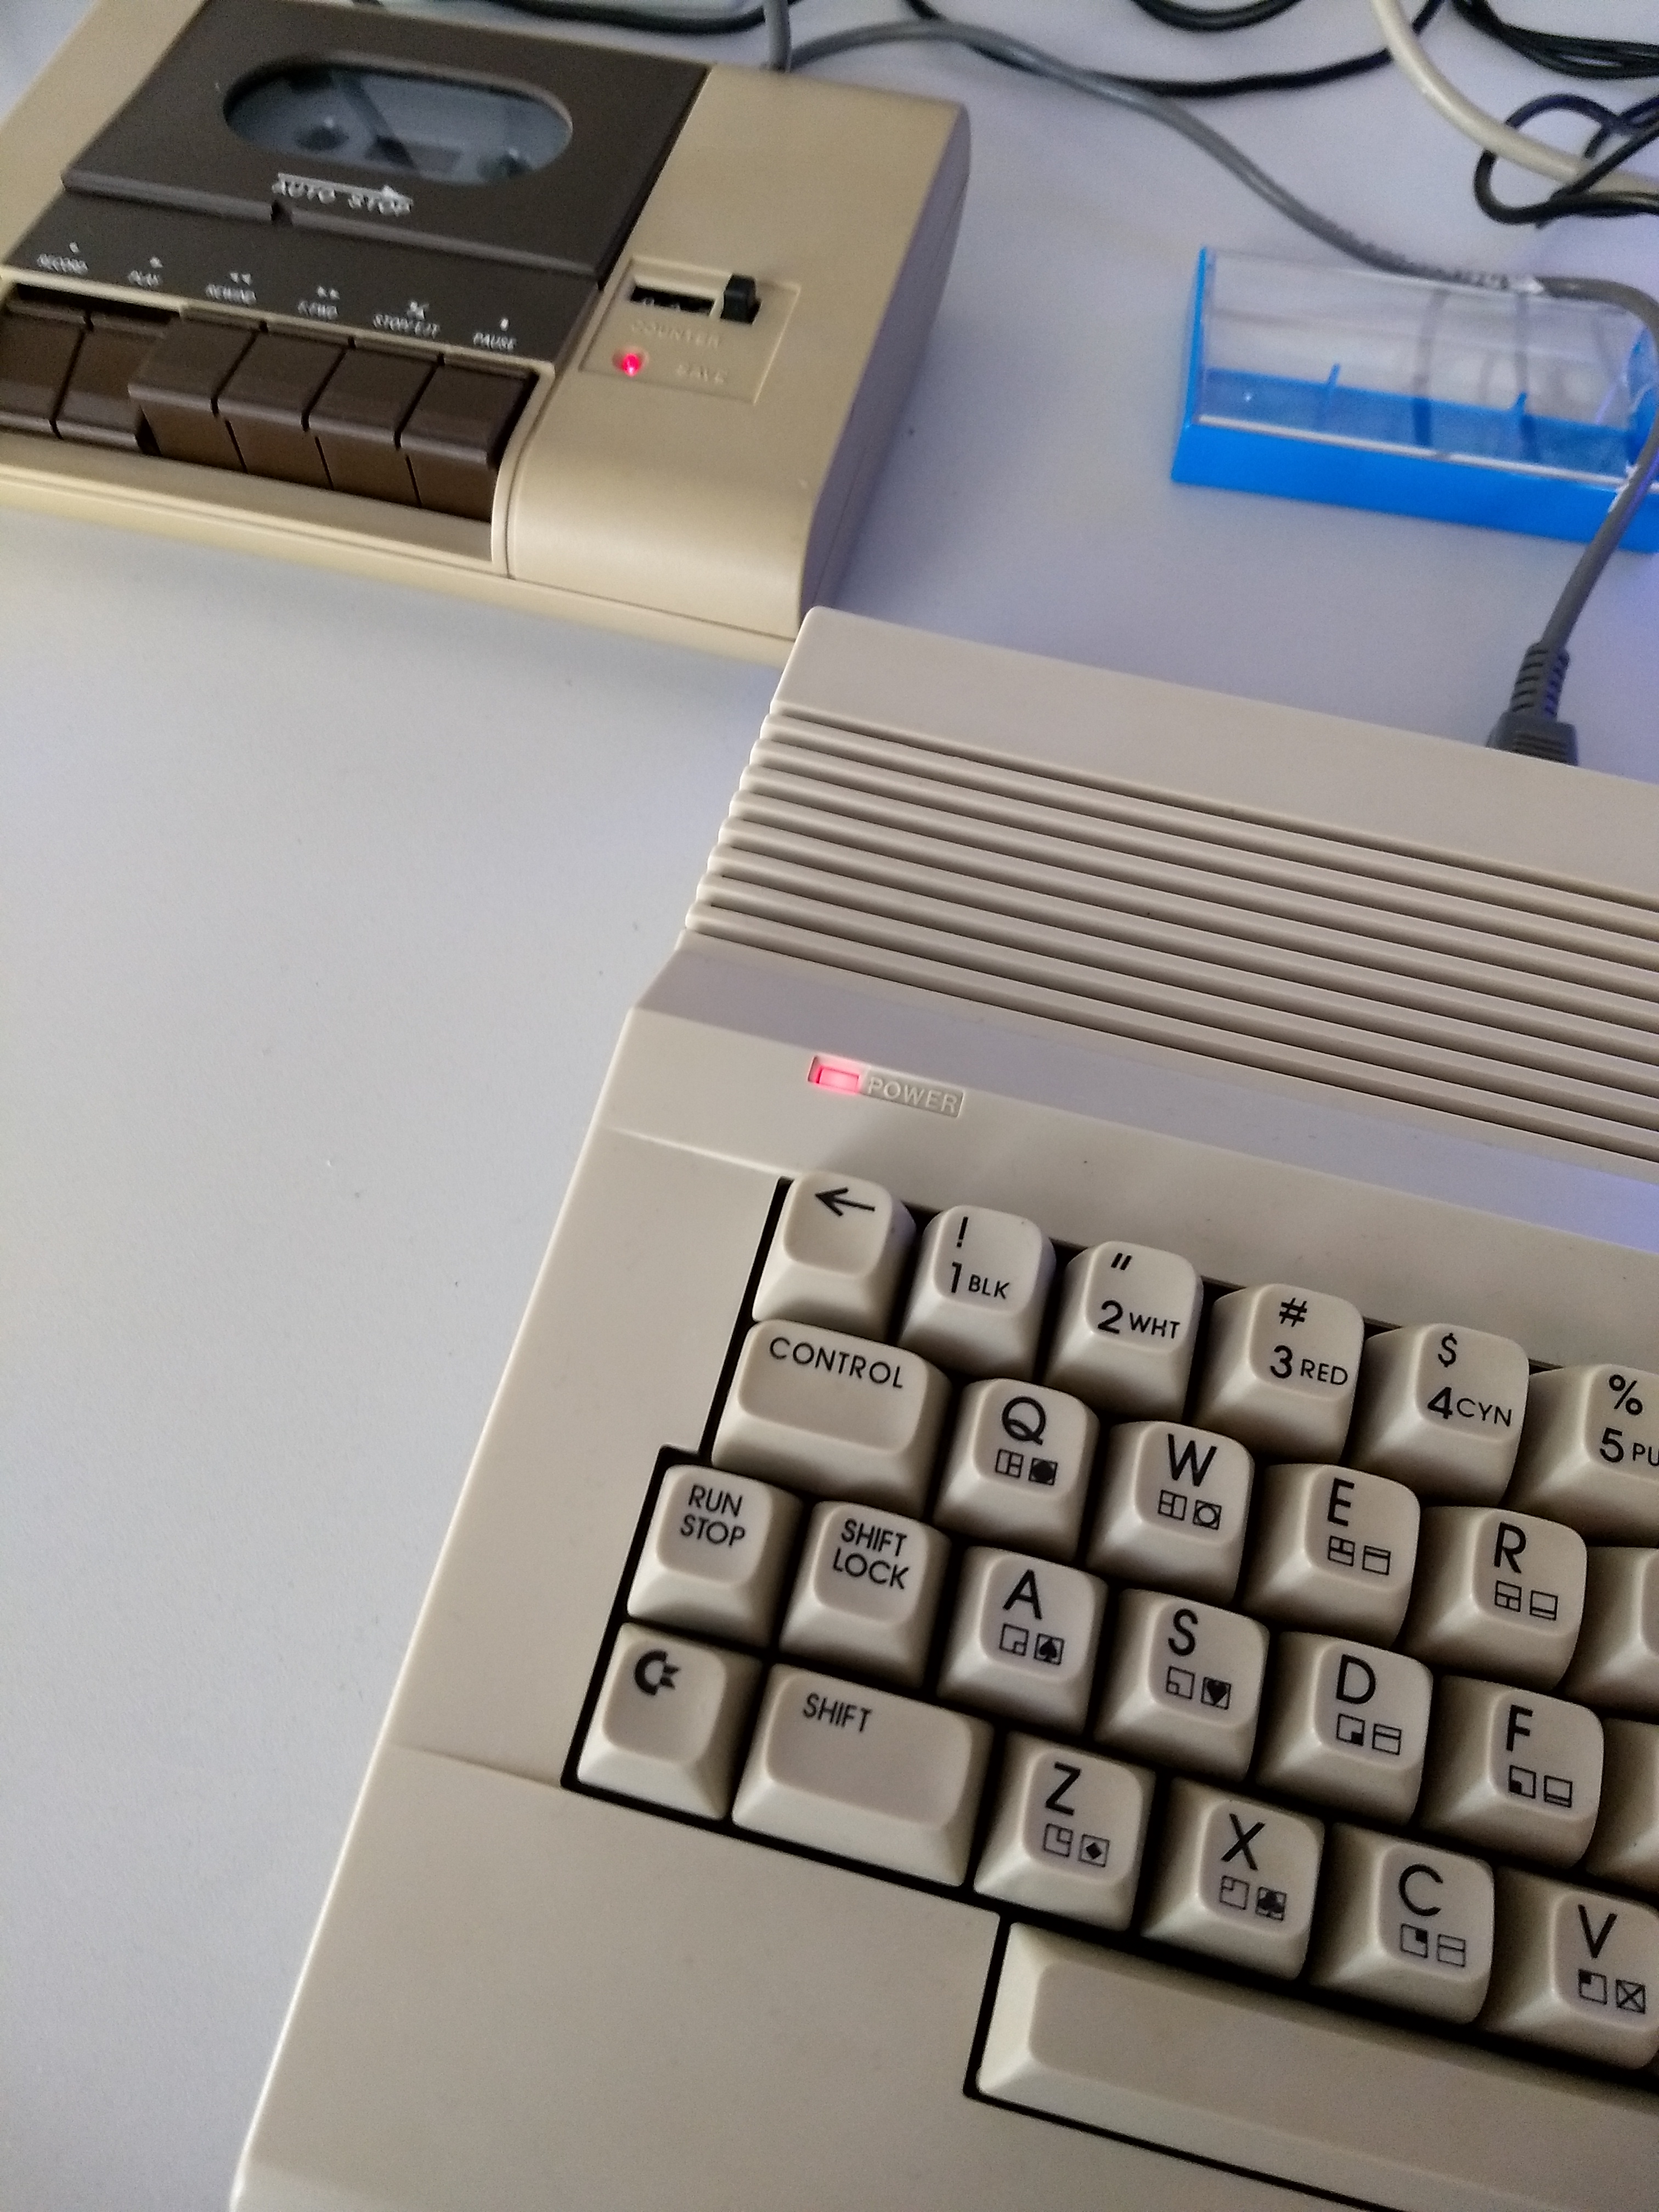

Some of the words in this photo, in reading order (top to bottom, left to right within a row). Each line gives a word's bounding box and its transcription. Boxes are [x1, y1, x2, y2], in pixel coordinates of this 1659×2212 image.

[272, 179, 336, 204] AUTO
[348, 192, 413, 217] STOP
[867, 1075, 958, 1114] POWER
[967, 1273, 1011, 1300] BLK
[1097, 1299, 1124, 1335] 2
[1129, 1311, 1181, 1340] WHT
[769, 1335, 904, 1389] CONTROL
[1269, 1344, 1294, 1380] 3
[1300, 1358, 1349, 1386] RED
[1001, 1396, 1047, 1446] Q
[1599, 1427, 1624, 1464] 5
[1167, 1432, 1218, 1488] W
[687, 1483, 744, 1519] RUN
[1327, 1476, 1356, 1527] E
[679, 1513, 747, 1548] STOP
[839, 1517, 909, 1558] SHIFT
[1493, 1521, 1527, 1575] R
[831, 1545, 910, 1591] LOCK
[1002, 1568, 1043, 1621] A
[1167, 1607, 1199, 1657] S
[1335, 1653, 1377, 1706] D
[802, 1691, 873, 1734] SHIFT
[1505, 1703, 1534, 1753] F
[1044, 1760, 1082, 1817] Z
[1220, 1813, 1266, 1871] X
[1397, 1863, 1444, 1917] C
[1577, 1903, 1618, 1960] V
